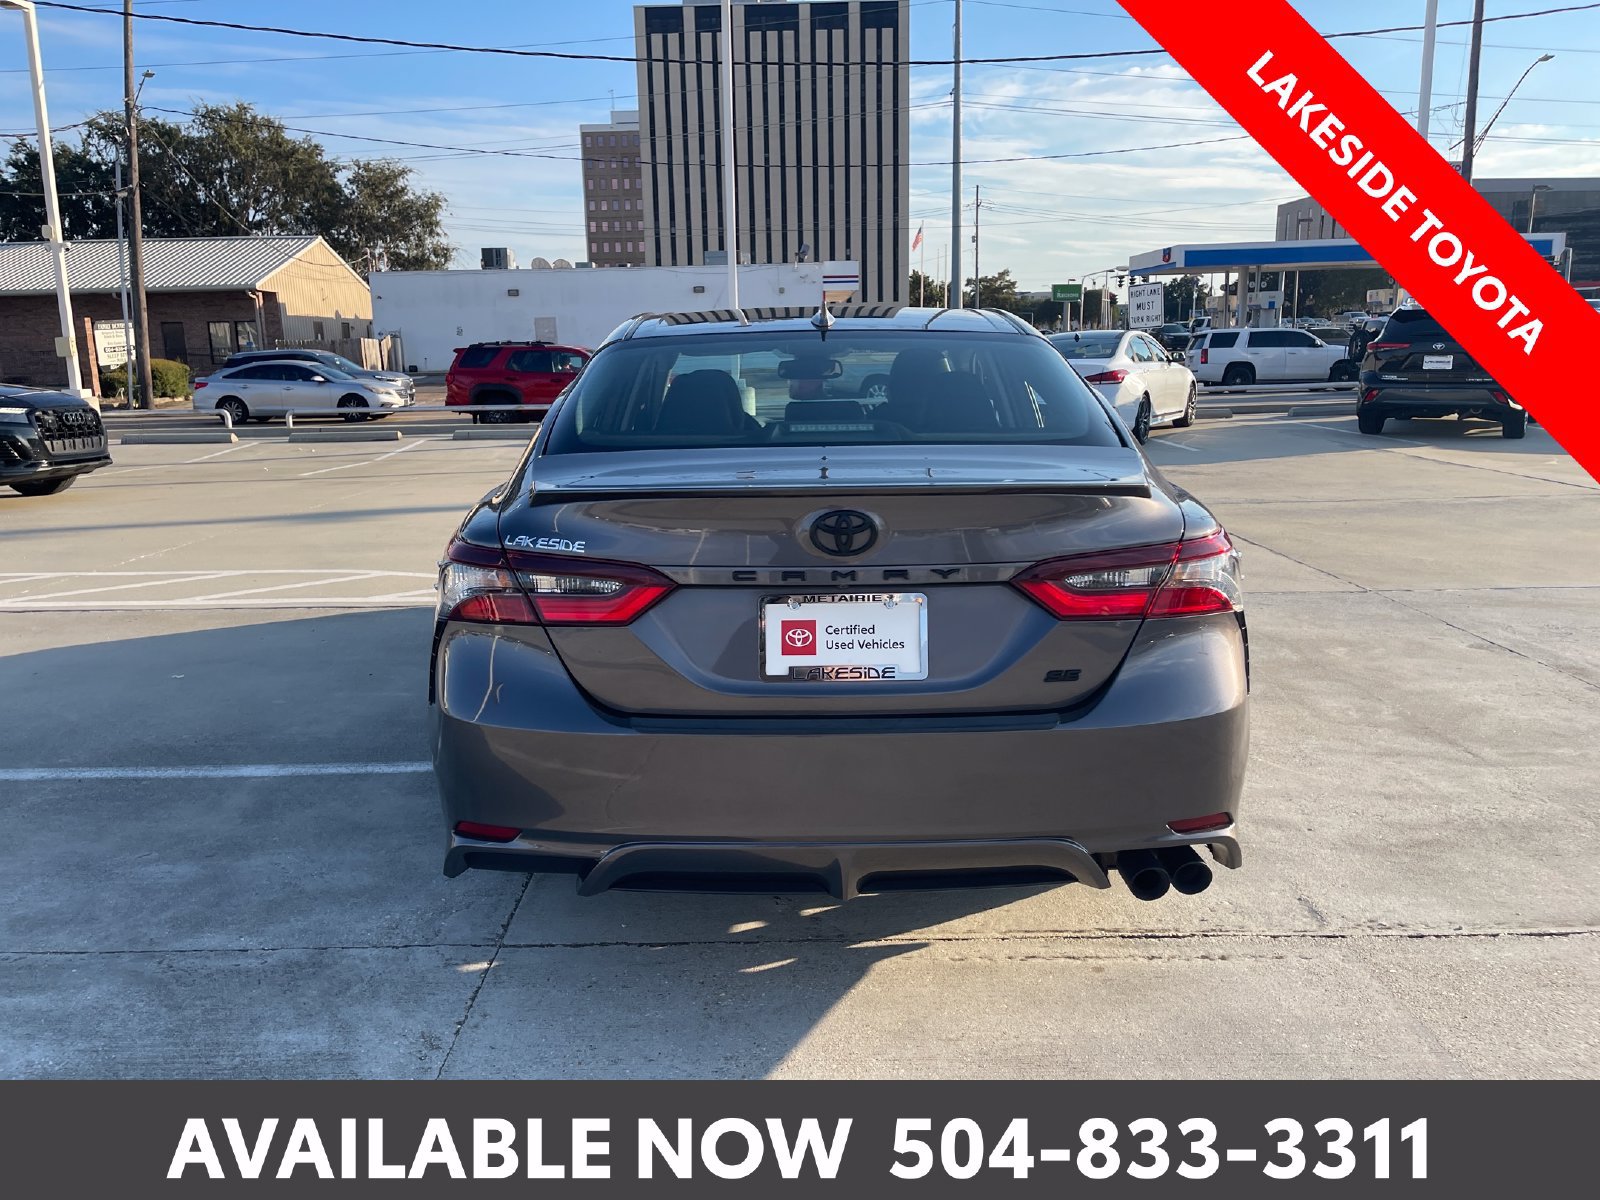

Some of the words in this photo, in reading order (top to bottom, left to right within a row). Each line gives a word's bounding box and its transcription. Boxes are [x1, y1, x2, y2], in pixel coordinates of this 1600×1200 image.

[1130, 289, 1145, 298] RIGHT
[1146, 287, 1160, 297] LANE
[1136, 300, 1155, 311] MUST
[1131, 316, 1144, 324] TURN
[1145, 314, 1161, 322] RIGHT
[504, 535, 586, 553] LAKESIDE
[732, 568, 960, 582] CAMRY
[803, 594, 882, 603] METAIRIE
[825, 625, 876, 635] Certified
[826, 639, 854, 650] Used
[857, 639, 905, 650] Vehicles
[1044, 669, 1082, 682] SE
